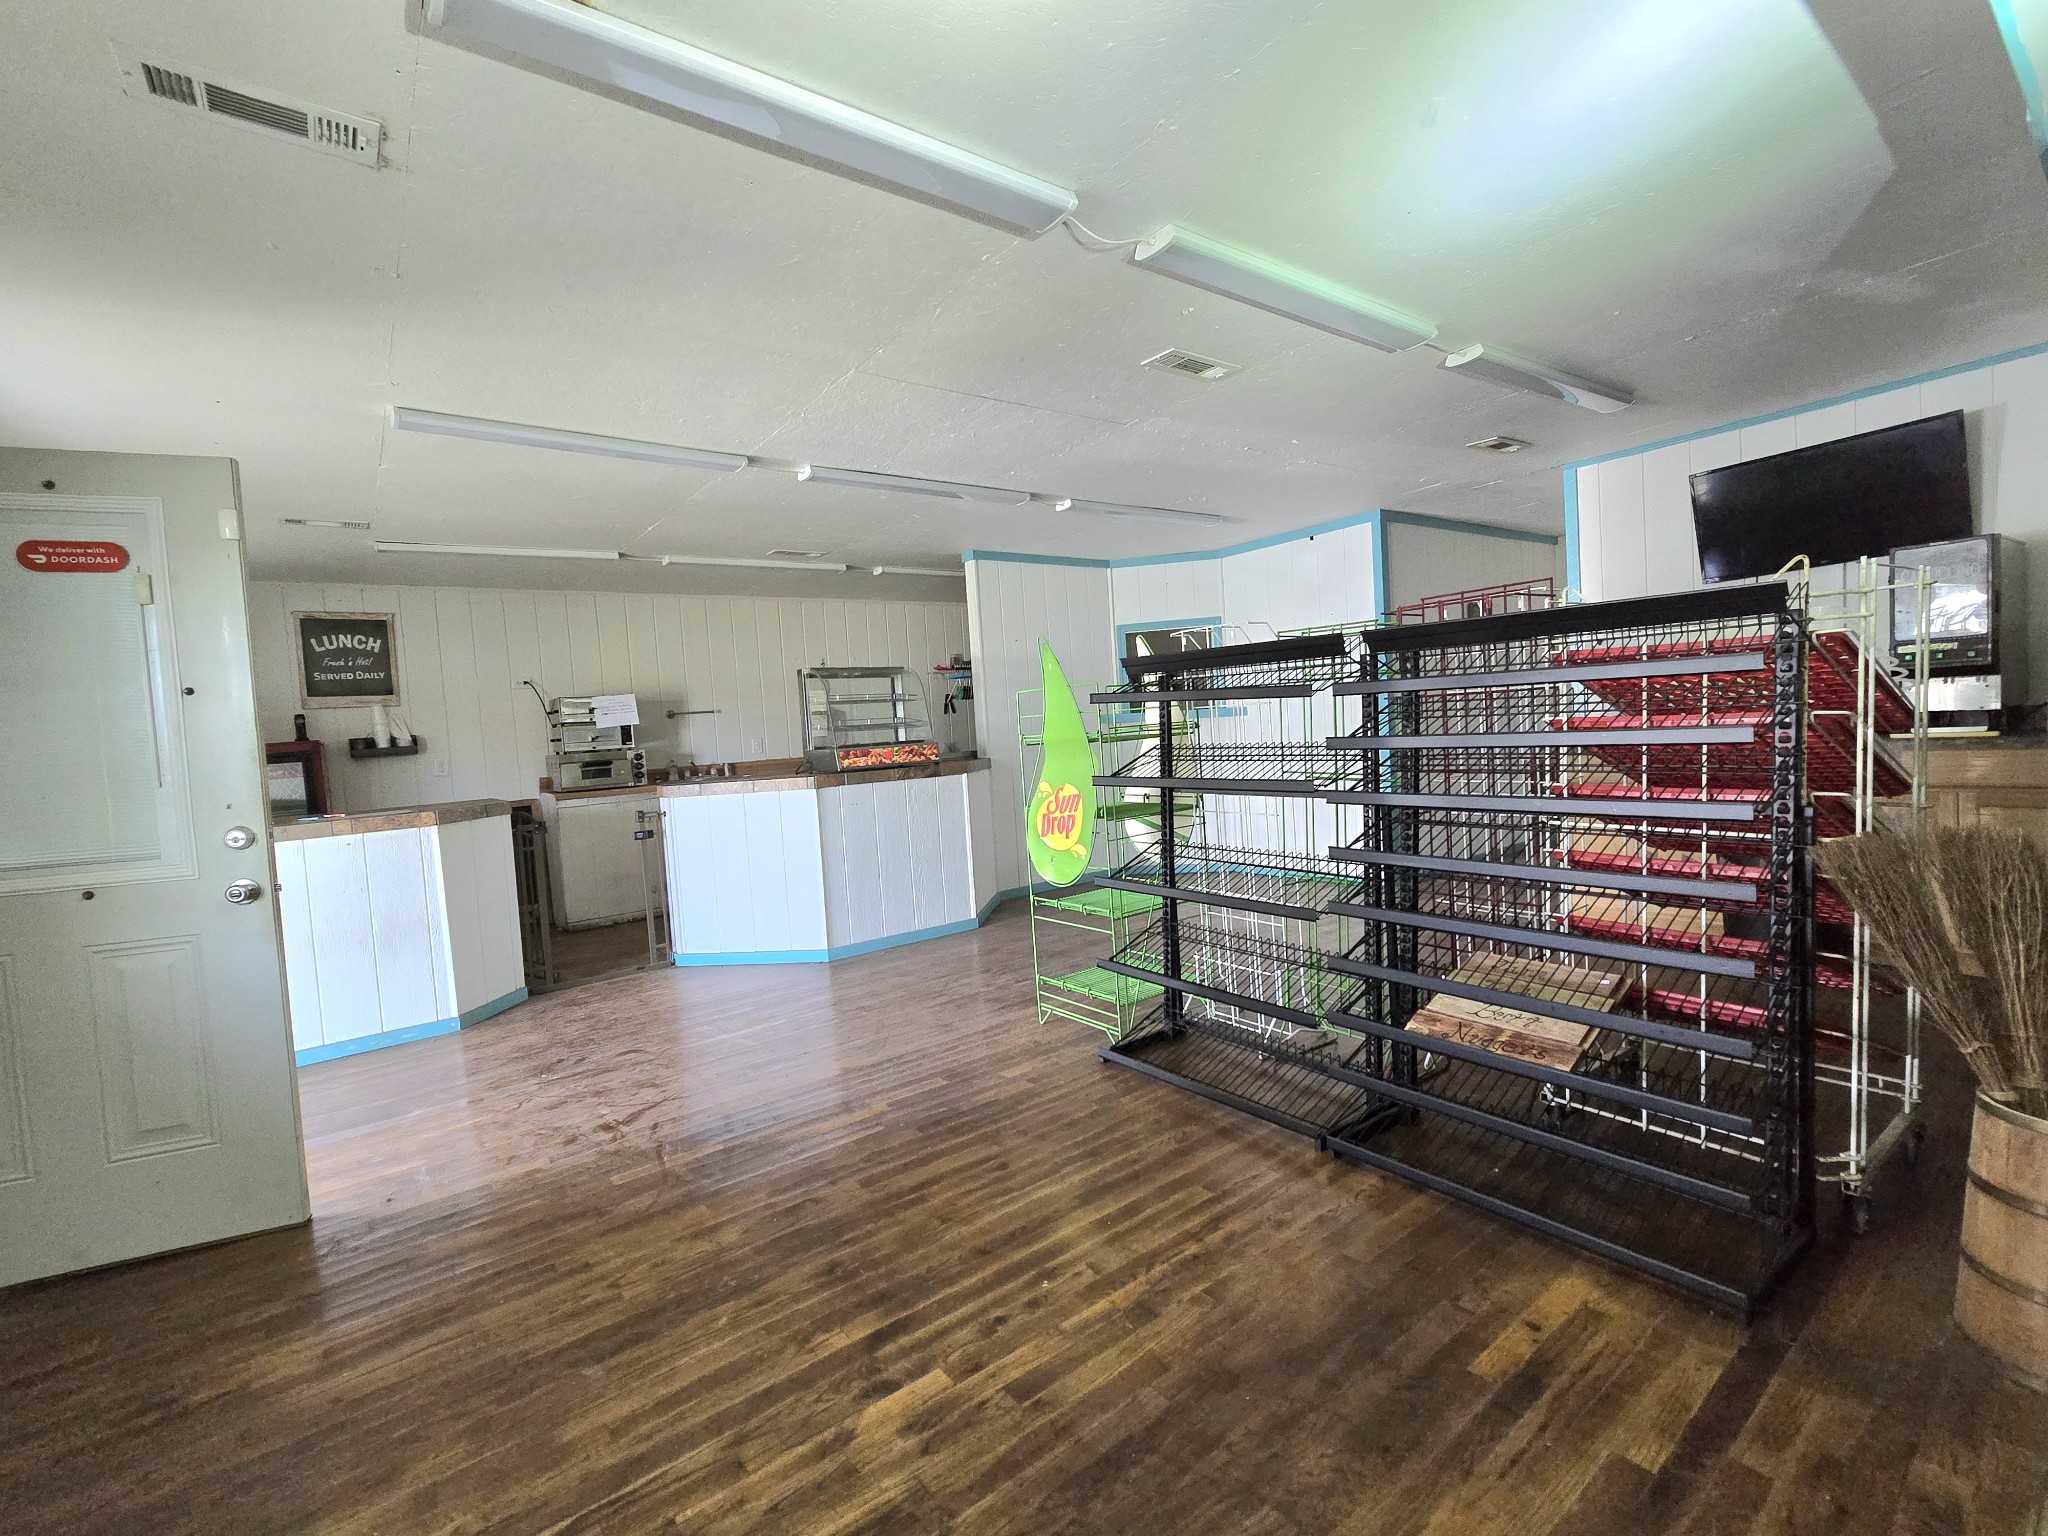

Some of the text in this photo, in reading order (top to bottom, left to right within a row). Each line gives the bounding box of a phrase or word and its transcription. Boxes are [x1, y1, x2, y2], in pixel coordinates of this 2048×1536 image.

[51, 556, 119, 564] DOORDASH
[310, 634, 381, 653] LUNCH
[1047, 786, 1081, 815] Sun
[1041, 813, 1076, 840] Drop
[1441, 1021, 1549, 1060] Nuggets
